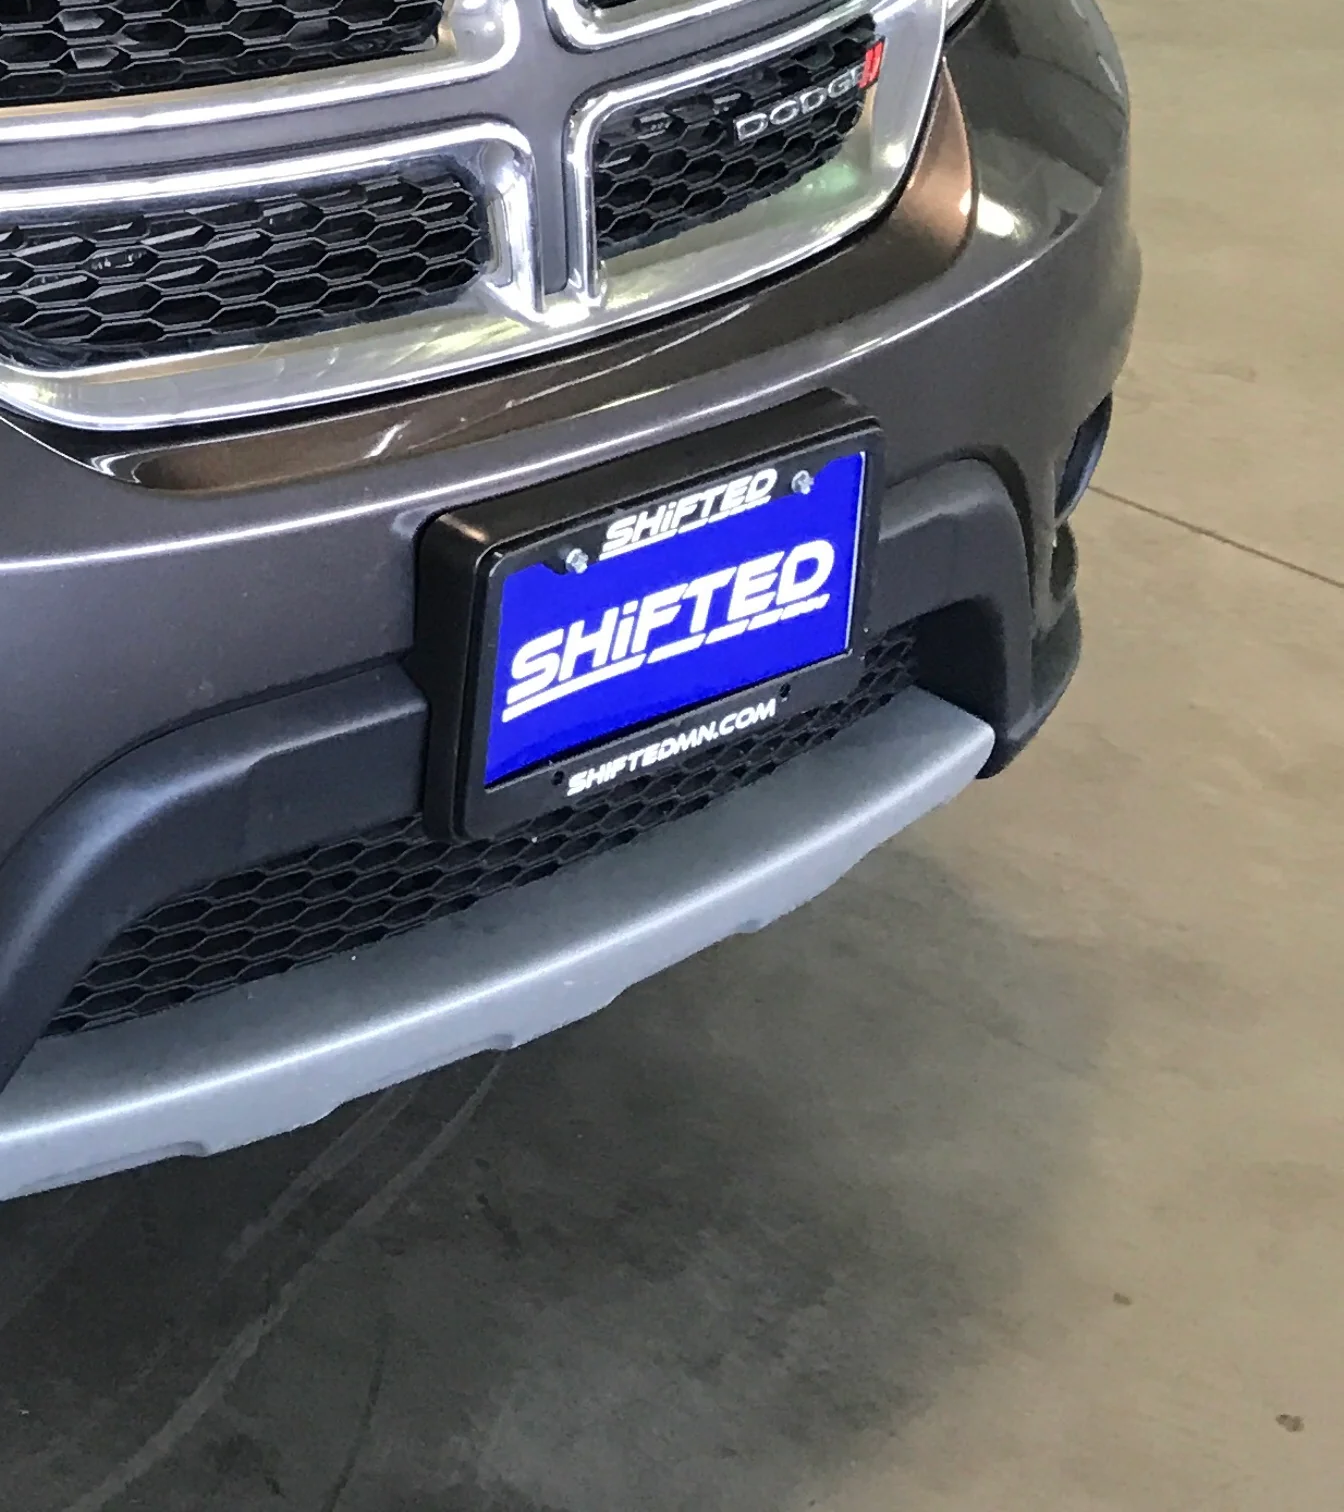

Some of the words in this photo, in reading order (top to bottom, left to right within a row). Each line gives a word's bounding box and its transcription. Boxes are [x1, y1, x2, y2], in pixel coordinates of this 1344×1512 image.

[602, 467, 778, 556] SHiFTED
[505, 539, 835, 707] SHiFTED
[566, 698, 777, 797] SHIFTEDMN.COM
